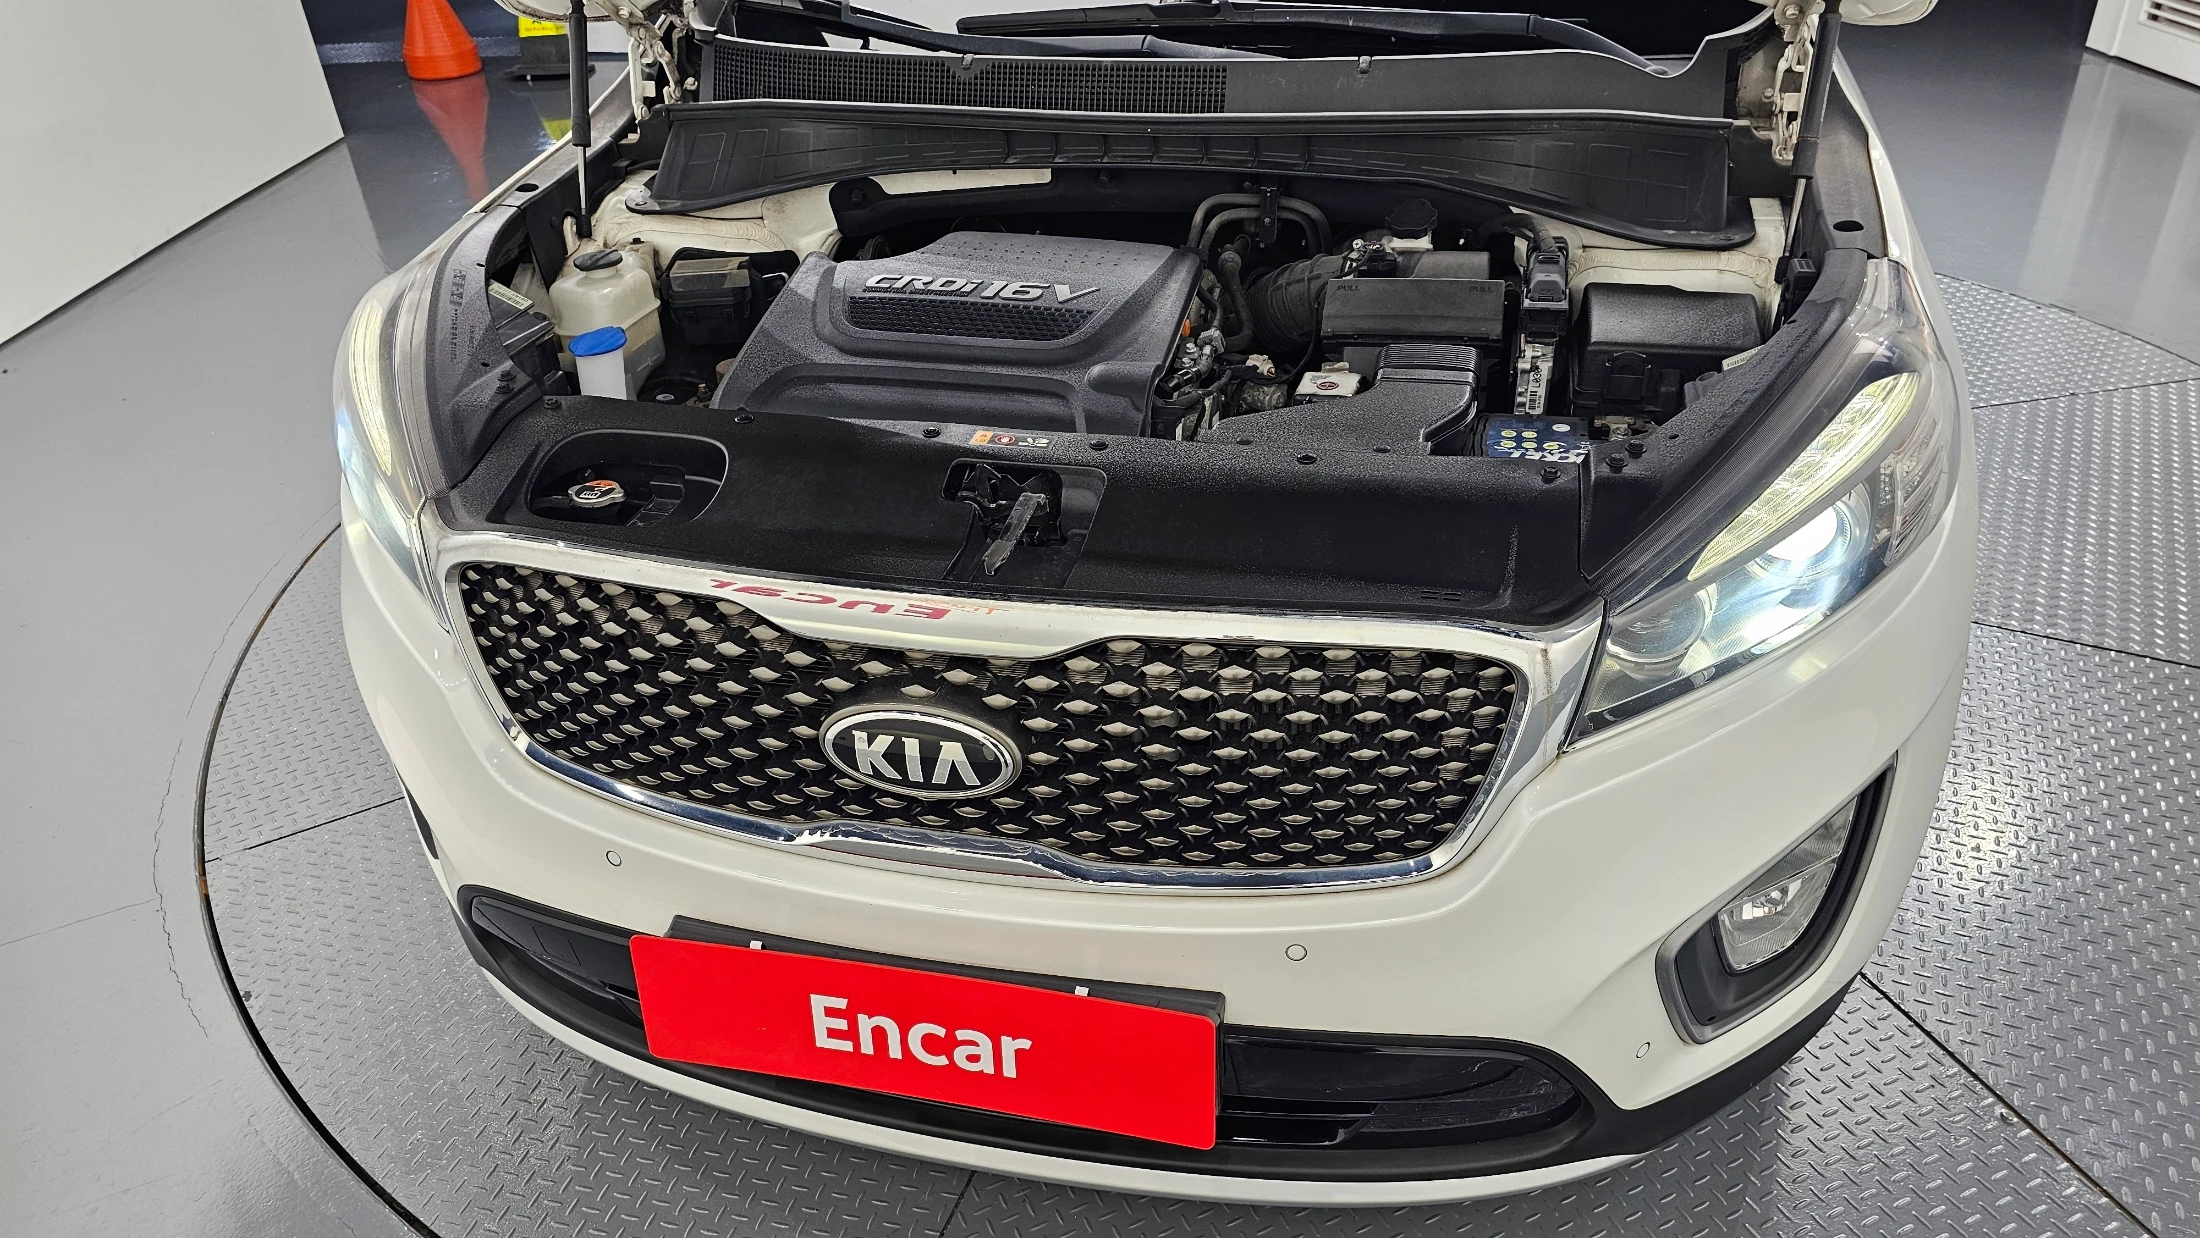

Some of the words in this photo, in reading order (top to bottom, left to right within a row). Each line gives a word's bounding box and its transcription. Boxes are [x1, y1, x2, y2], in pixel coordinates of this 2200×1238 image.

[865, 275, 984, 293] CRDi
[980, 280, 1100, 304] 16V
[1337, 284, 1361, 292] PULL
[852, 729, 981, 786] KIA
[809, 993, 1033, 1079] Encar
